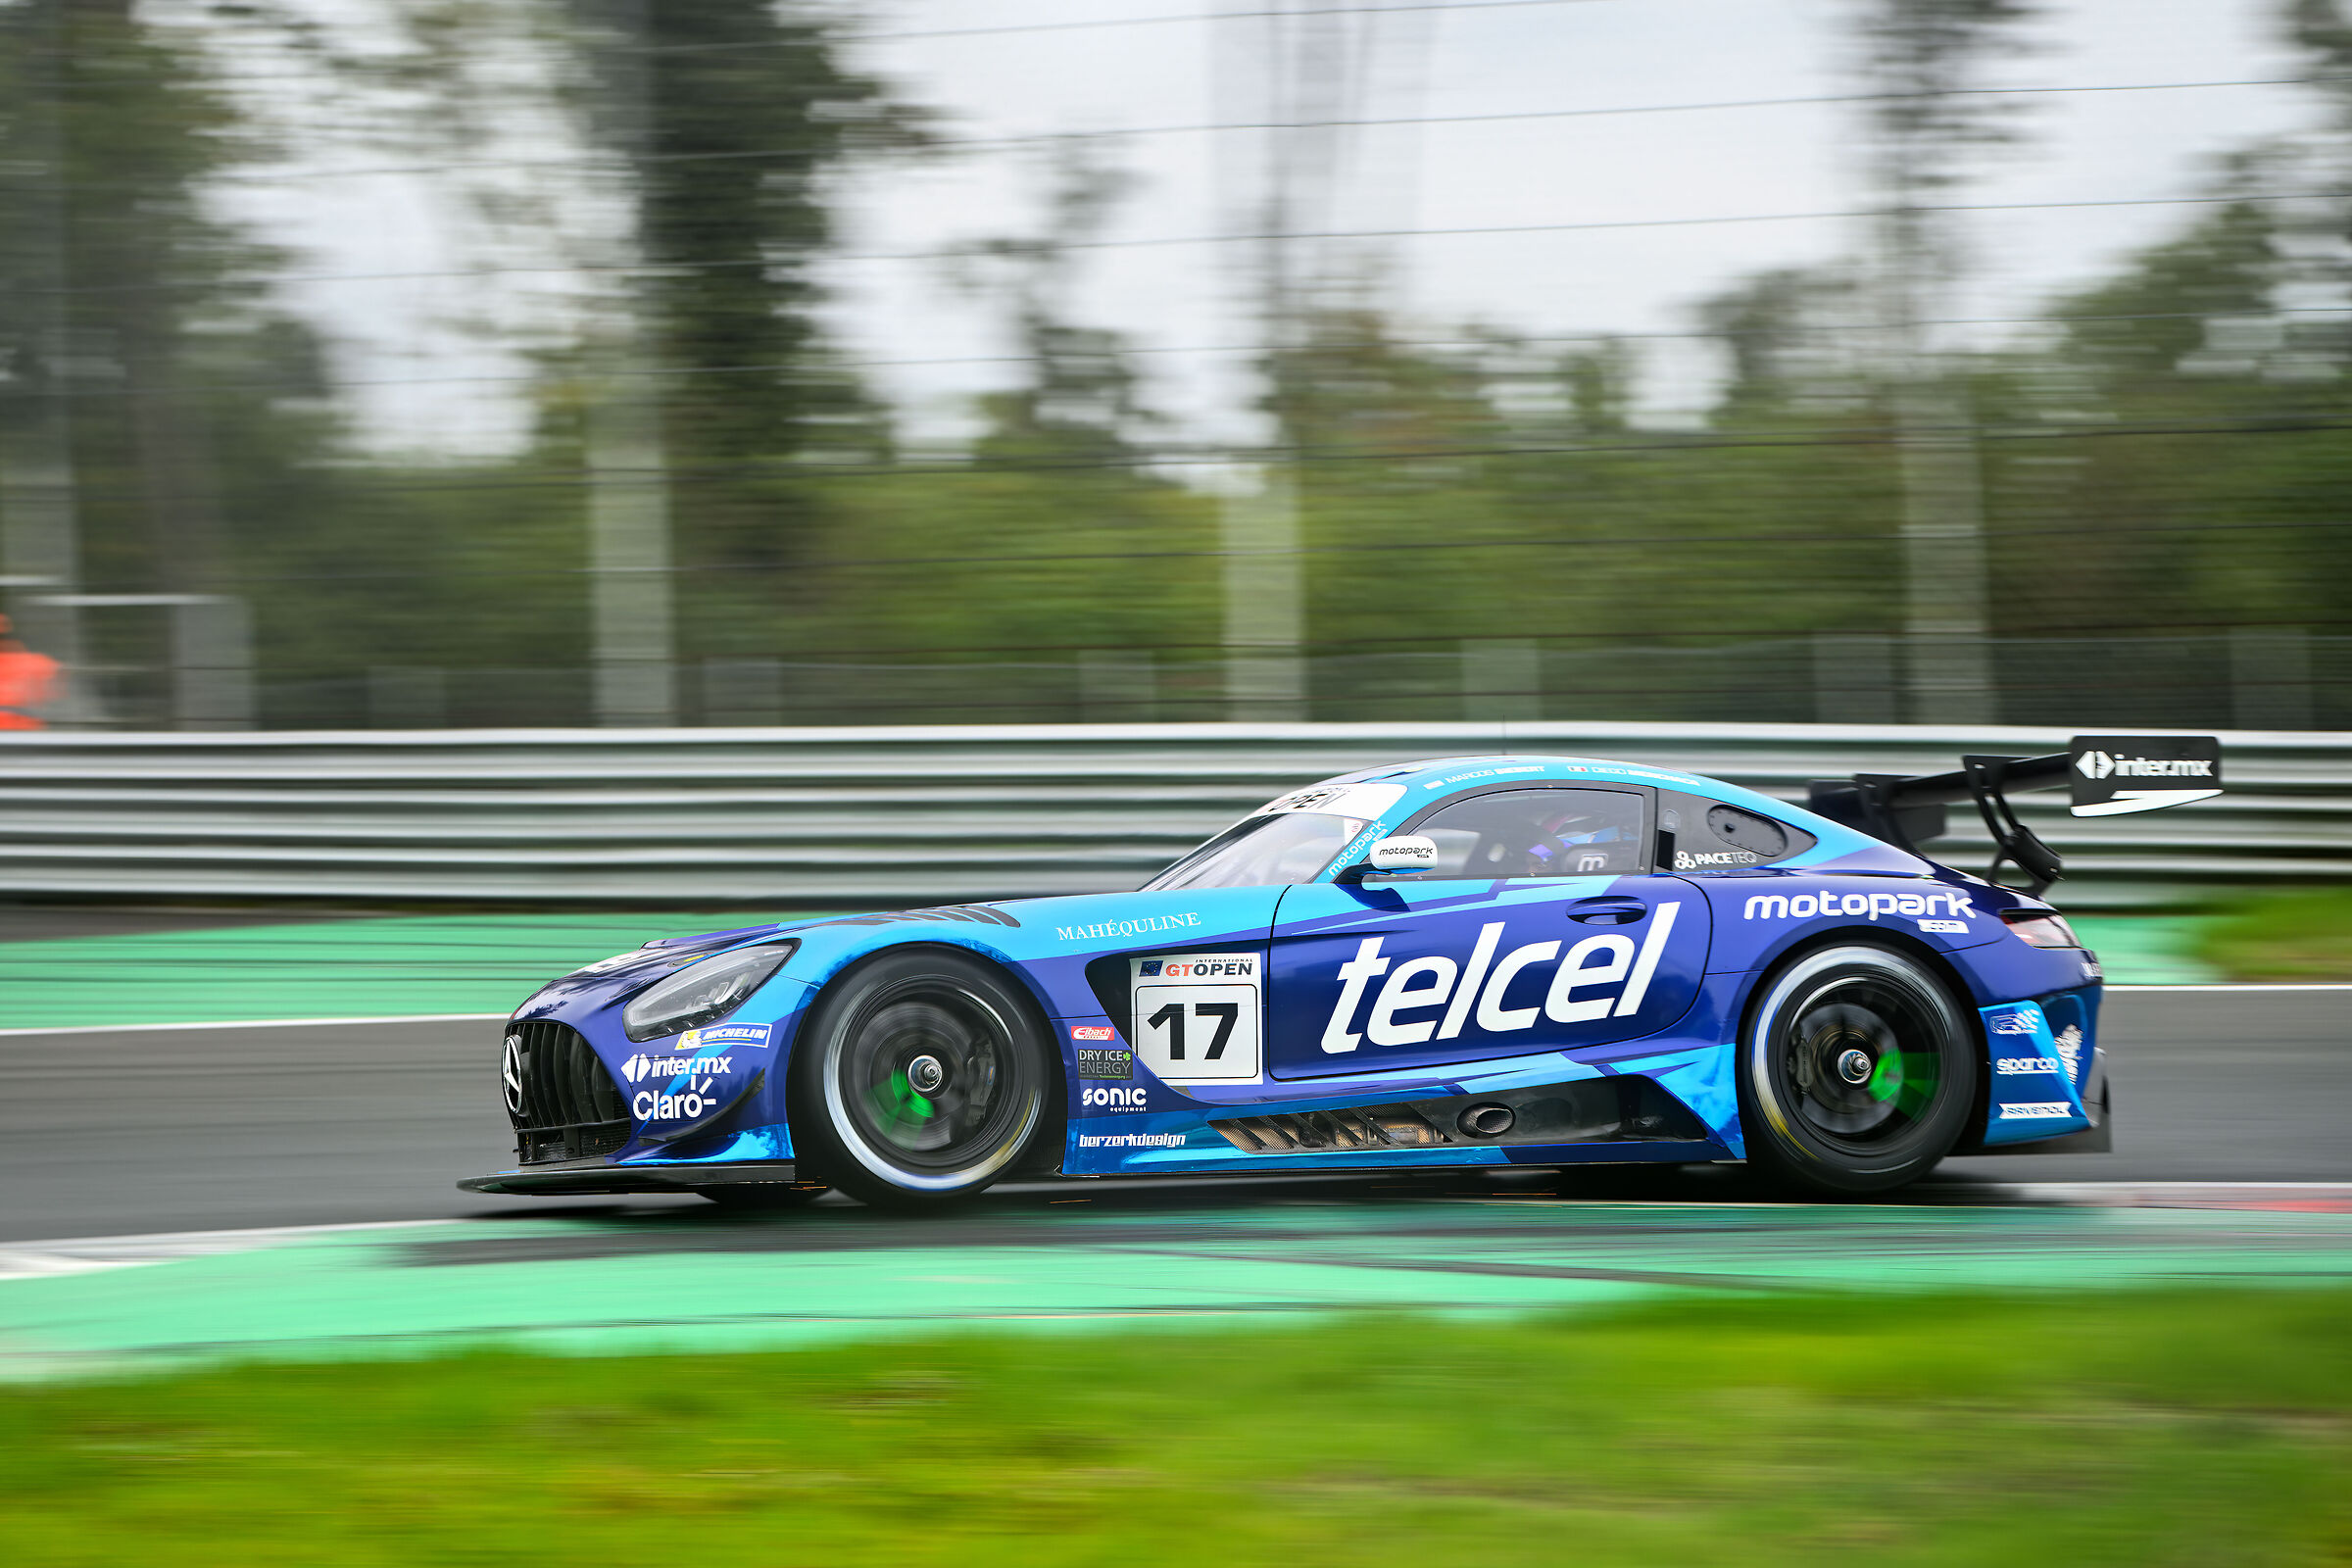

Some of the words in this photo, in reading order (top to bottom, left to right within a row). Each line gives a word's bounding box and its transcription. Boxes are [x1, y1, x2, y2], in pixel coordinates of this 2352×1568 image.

[2114, 754, 2213, 777] inter.mx
[1328, 820, 1387, 877] motopark
[1379, 847, 1434, 857] motopark
[1693, 852, 1757, 865] PACETEQ
[1743, 890, 1977, 921] motopark
[1055, 911, 1201, 941] MAHÉQULINE
[1320, 901, 1682, 1054] telcel
[704, 1028, 767, 1040] MICHELIN
[1147, 1003, 1239, 1060] 17
[651, 1055, 732, 1077] inter.mx
[1079, 1051, 1102, 1061] DRY
[1105, 1051, 1123, 1061] ICE
[1079, 1061, 1131, 1074] ENERGY
[632, 1091, 704, 1122] Claro
[1079, 1133, 1186, 1148] berzerkdesign
